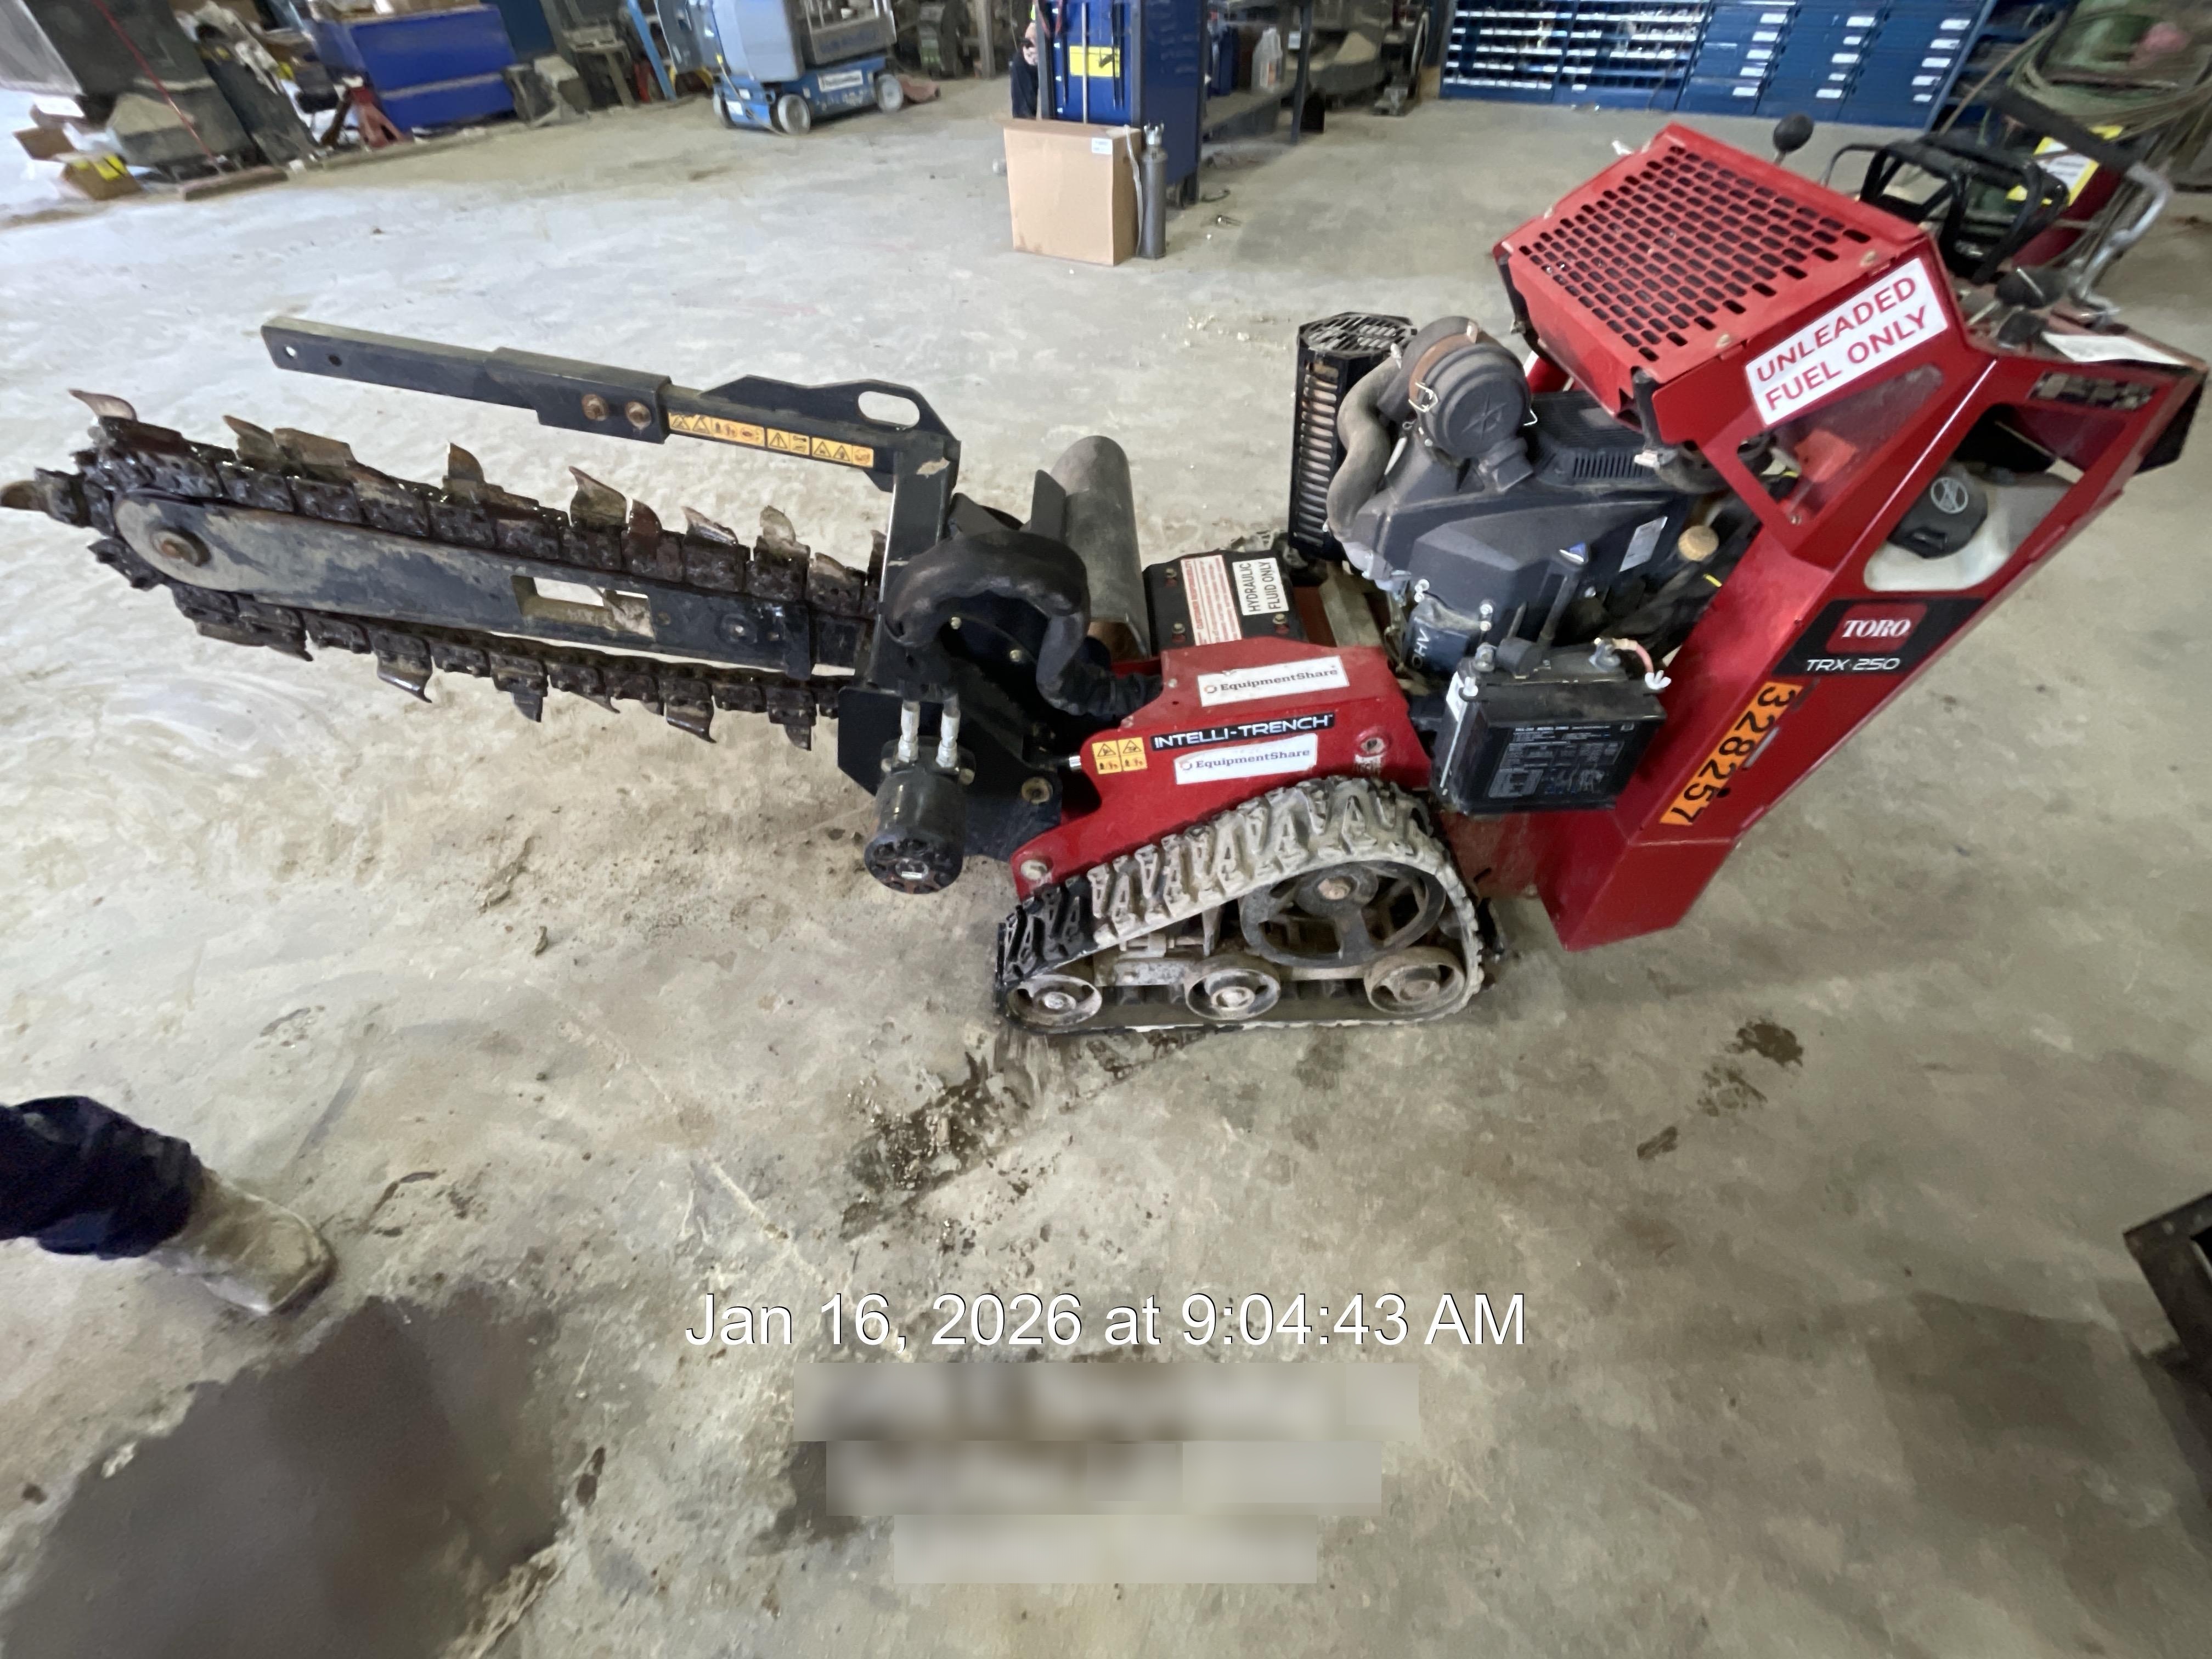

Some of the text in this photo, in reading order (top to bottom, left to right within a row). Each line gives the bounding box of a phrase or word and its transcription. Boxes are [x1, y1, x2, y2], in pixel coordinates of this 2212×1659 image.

[1757, 277, 1916, 382] UNLEADED
[1764, 304, 1927, 411] FUEL ONLY
[1239, 562, 1261, 612] HYDRAULIC
[1259, 561, 1282, 610] FLUID ONLY
[1411, 627, 1430, 669] OHV
[1841, 619, 1912, 638] TORO
[1220, 669, 1338, 691] EquipmentShare
[1807, 658, 1901, 672] TRX 250
[1195, 749, 1310, 768] EquipmentShare
[1671, 686, 1796, 822] 328257
